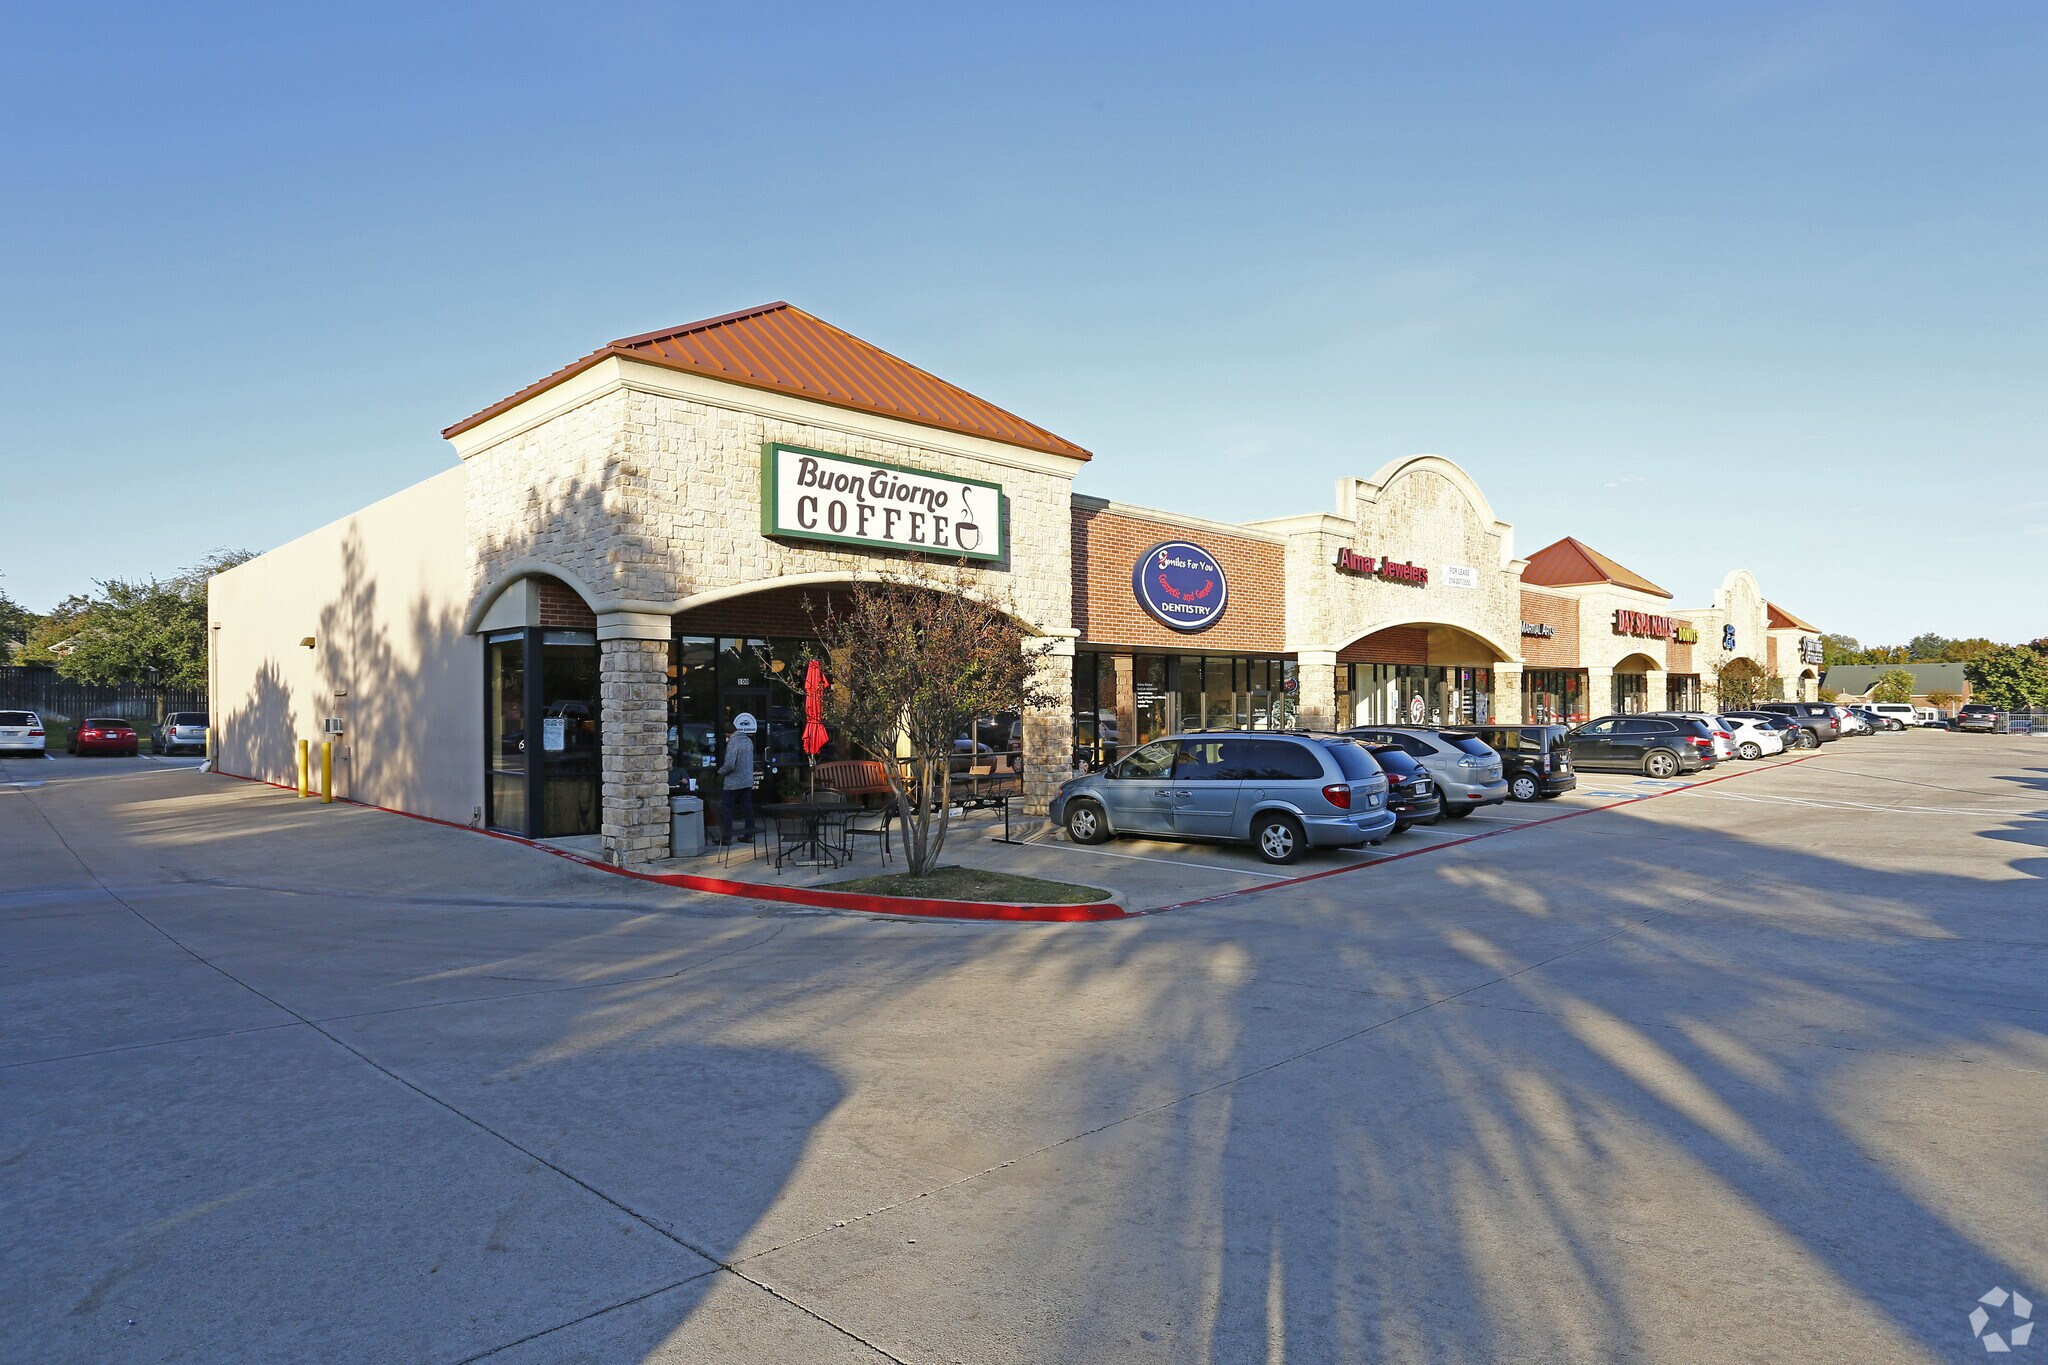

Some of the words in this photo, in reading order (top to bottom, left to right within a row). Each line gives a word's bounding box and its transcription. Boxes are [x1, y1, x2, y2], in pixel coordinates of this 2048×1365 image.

[797, 457, 865, 502] Buon
[868, 469, 948, 512] Giorno
[797, 495, 949, 547] COFFEE
[1158, 550, 1186, 570] Smiles
[1187, 559, 1199, 570] For
[1199, 561, 1213, 572] You
[1340, 547, 1376, 573] Almar
[1381, 556, 1429, 584] Jewelers
[1158, 574, 1180, 599] Cosmetic
[1183, 592, 1195, 602] and
[1162, 602, 1211, 615] DENTISTRY
[1617, 609, 1636, 632] DAY
[1636, 612, 1651, 634] SPA
[1652, 615, 1673, 637] NAILS
[1679, 627, 1699, 643] DONUTS
